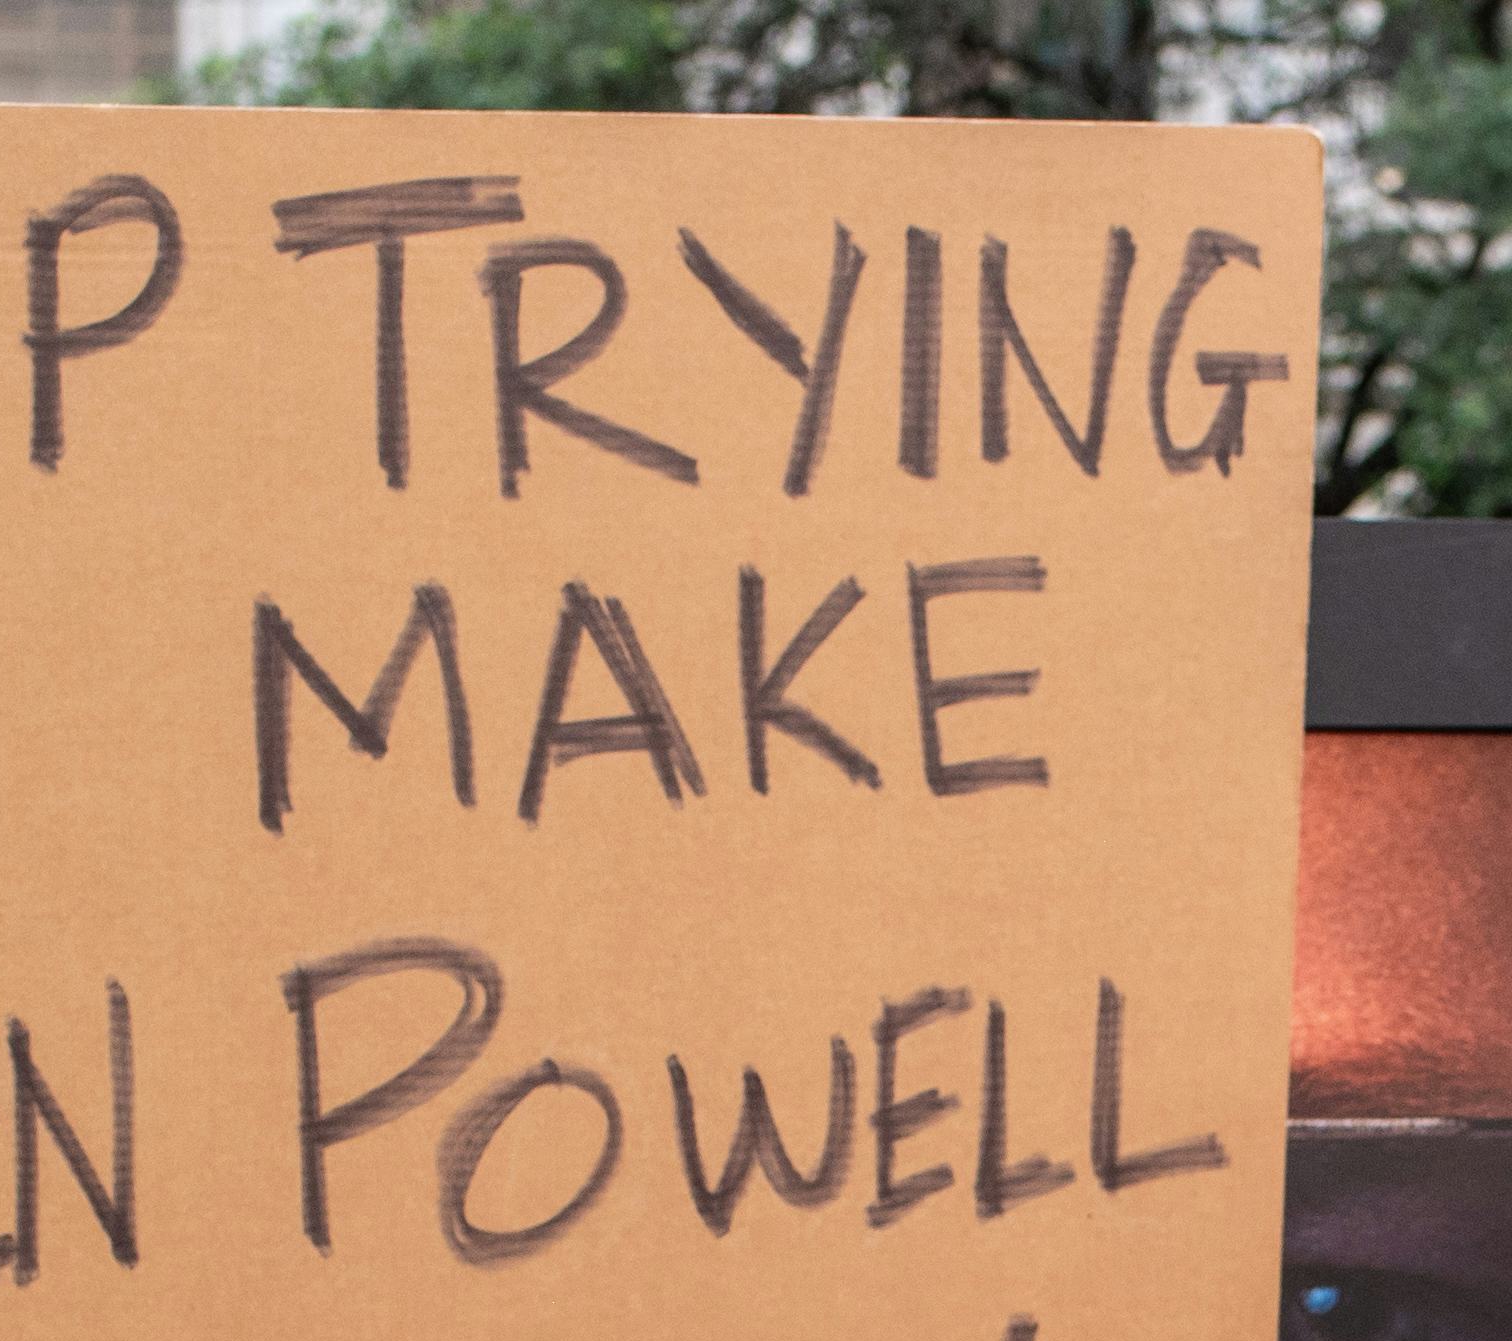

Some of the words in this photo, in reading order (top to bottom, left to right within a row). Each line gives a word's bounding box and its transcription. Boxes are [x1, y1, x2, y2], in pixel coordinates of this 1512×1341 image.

[272, 174, 1291, 499] TRYING
[251, 555, 1051, 837] MAKE
[280, 936, 1229, 1267] POWELL
